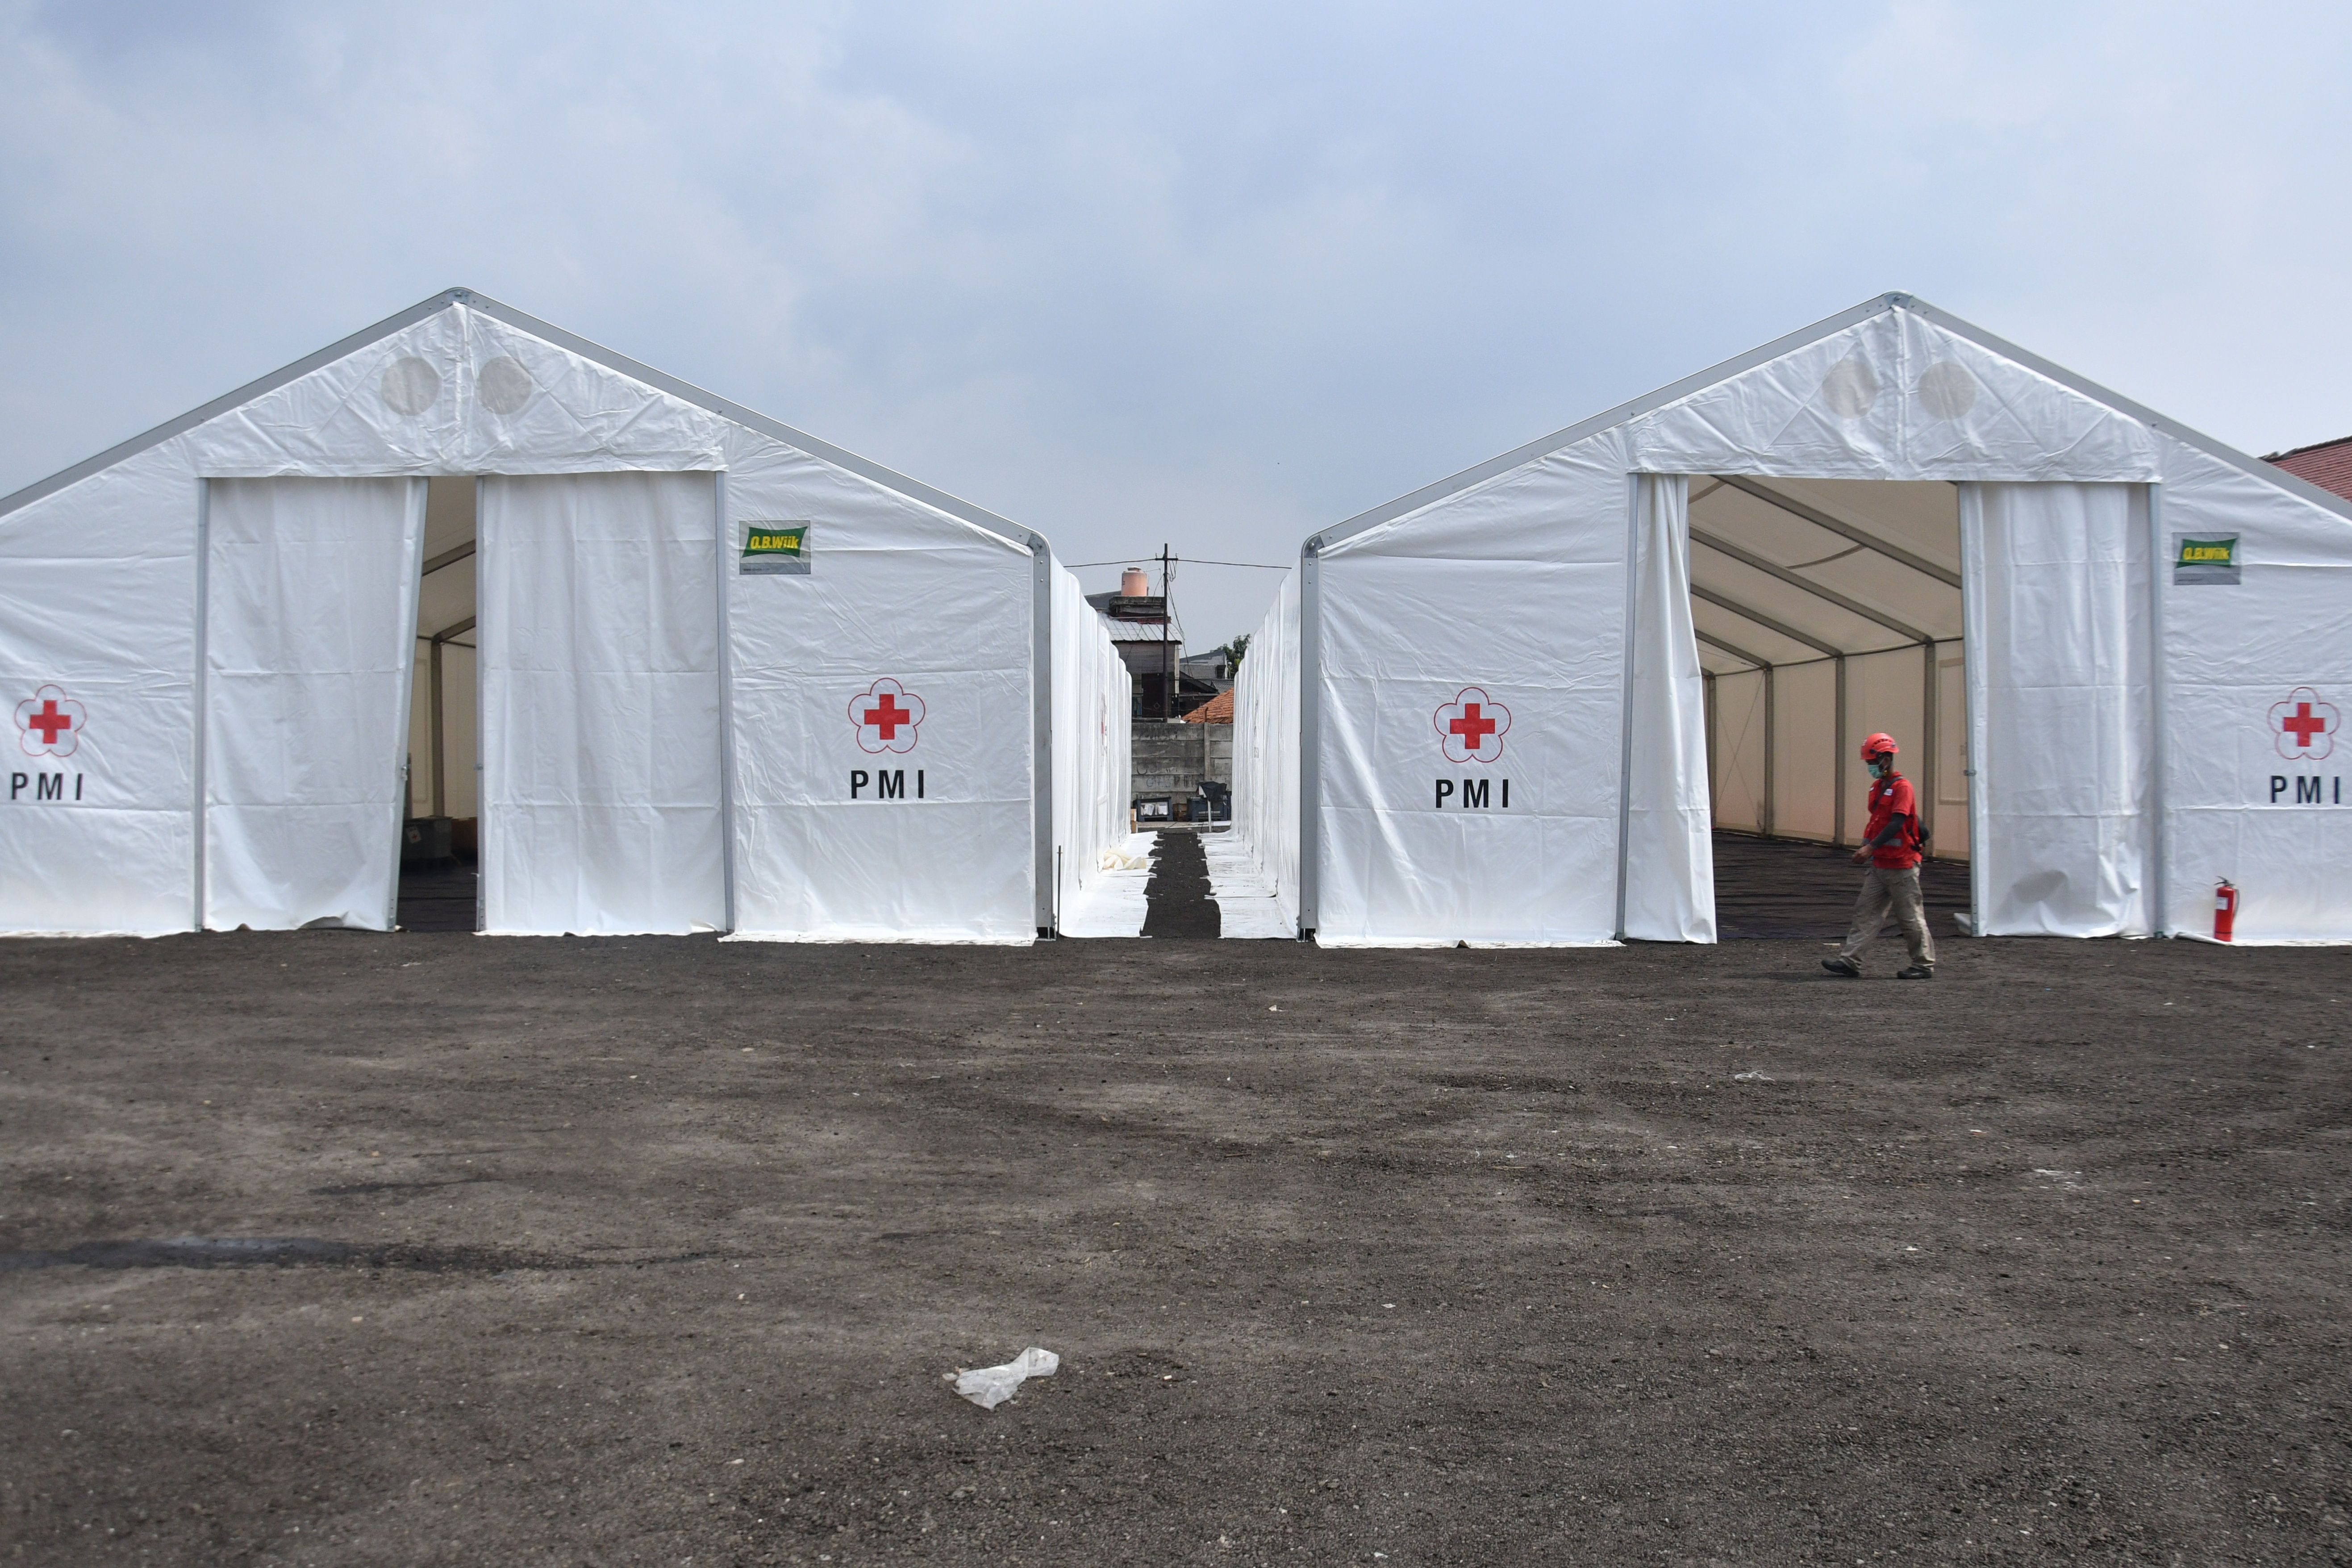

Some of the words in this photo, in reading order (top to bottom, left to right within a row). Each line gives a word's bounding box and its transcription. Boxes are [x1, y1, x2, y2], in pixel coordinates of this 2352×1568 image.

[750, 535, 800, 549] O.B.Wiik
[11, 772, 83, 801] PMI
[851, 770, 924, 799] PMI
[1435, 779, 1509, 809] PMI
[2270, 775, 2341, 805] PMI
